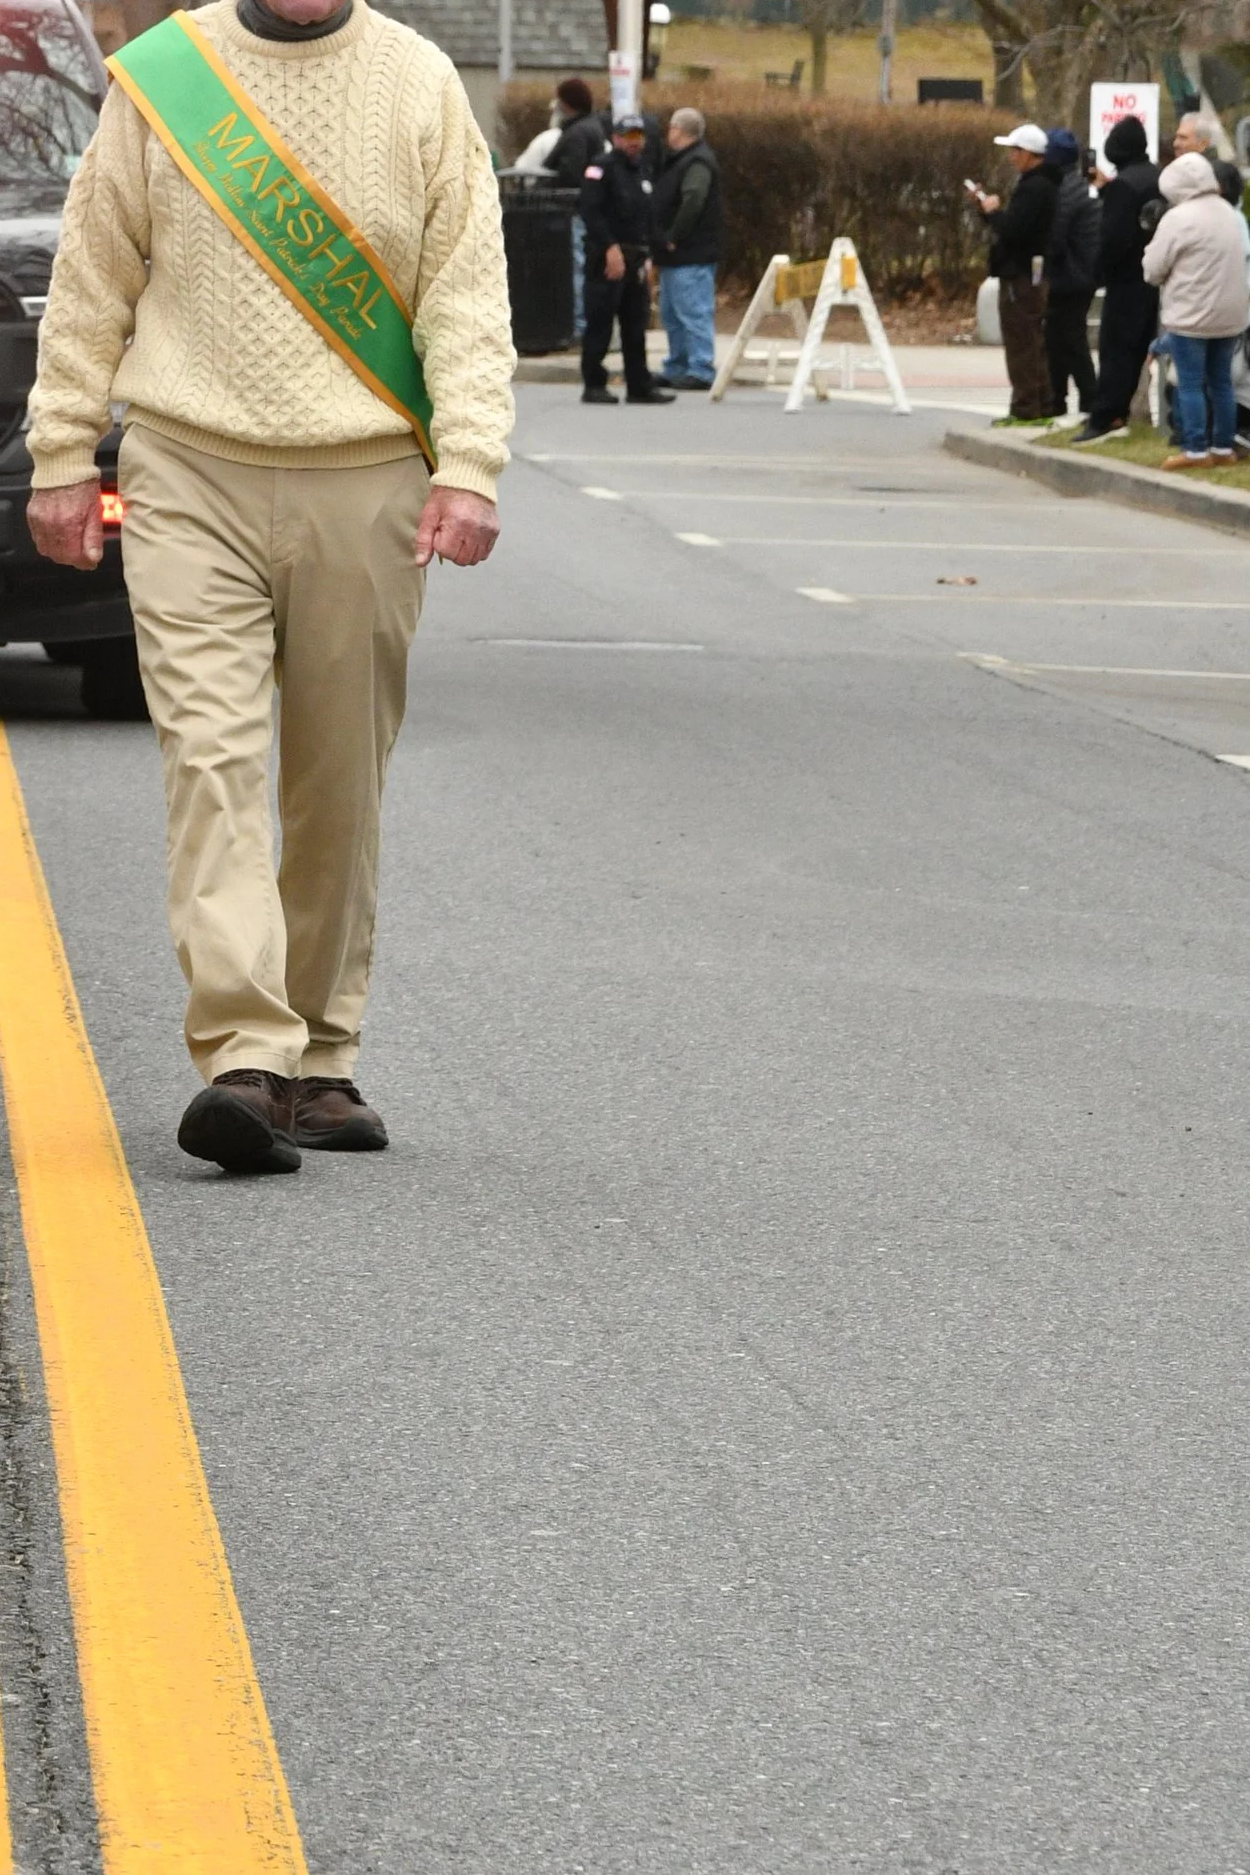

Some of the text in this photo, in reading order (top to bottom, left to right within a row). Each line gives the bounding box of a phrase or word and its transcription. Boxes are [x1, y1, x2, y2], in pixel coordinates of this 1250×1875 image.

[1113, 93, 1137, 109] NO
[207, 112, 382, 330] MARSHAL
[248, 208, 274, 239] Saint
[311, 282, 330, 306] Day
[331, 306, 363, 339] Parade
